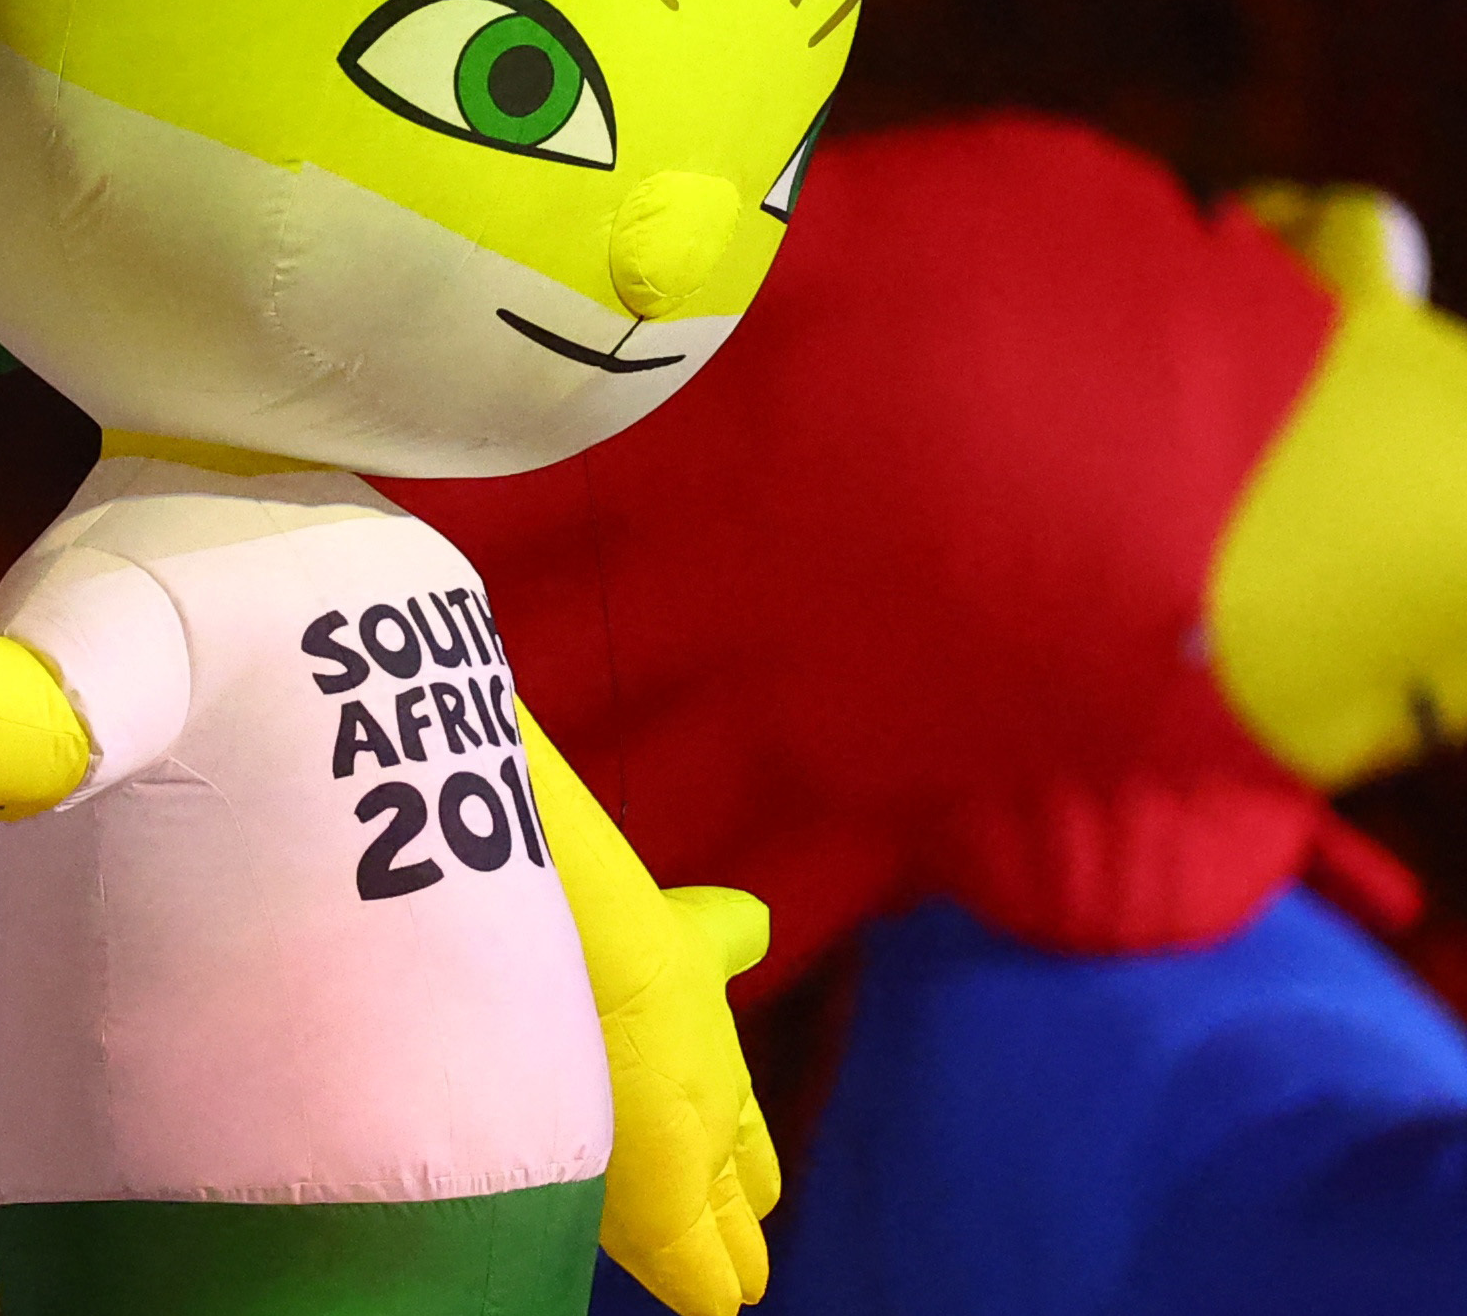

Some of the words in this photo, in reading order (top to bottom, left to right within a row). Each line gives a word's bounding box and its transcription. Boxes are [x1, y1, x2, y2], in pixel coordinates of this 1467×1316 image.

[301, 588, 505, 695] SOUTH
[333, 675, 523, 779] AFRIC
[354, 756, 555, 901] 201
